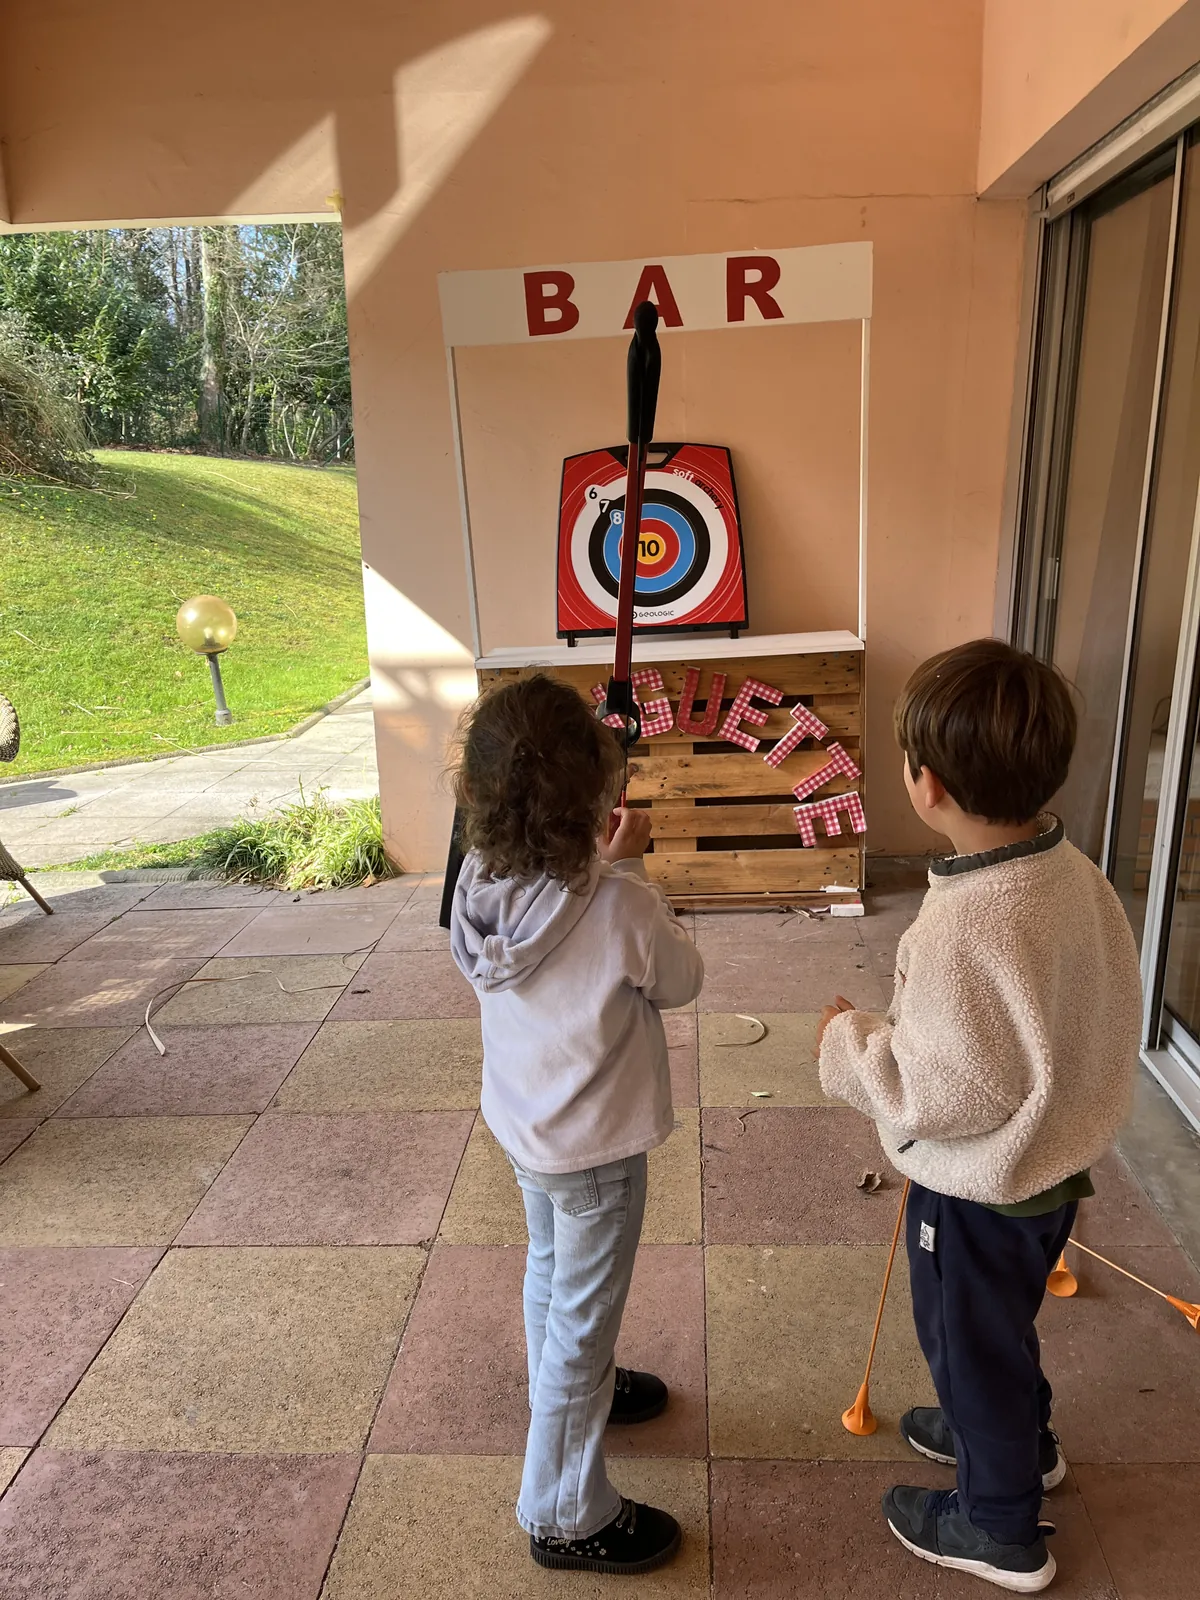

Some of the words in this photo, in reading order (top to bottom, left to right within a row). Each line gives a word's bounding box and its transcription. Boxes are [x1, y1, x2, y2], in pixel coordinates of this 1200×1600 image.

[523, 255, 785, 337] BAR
[589, 487, 598, 500] 6
[672, 468, 695, 482] soft
[694, 479, 725, 510] archery
[600, 500, 610, 514] 7
[613, 512, 623, 525] 8
[638, 540, 660, 557] 10
[547, 1537, 571, 1549] Lovely
